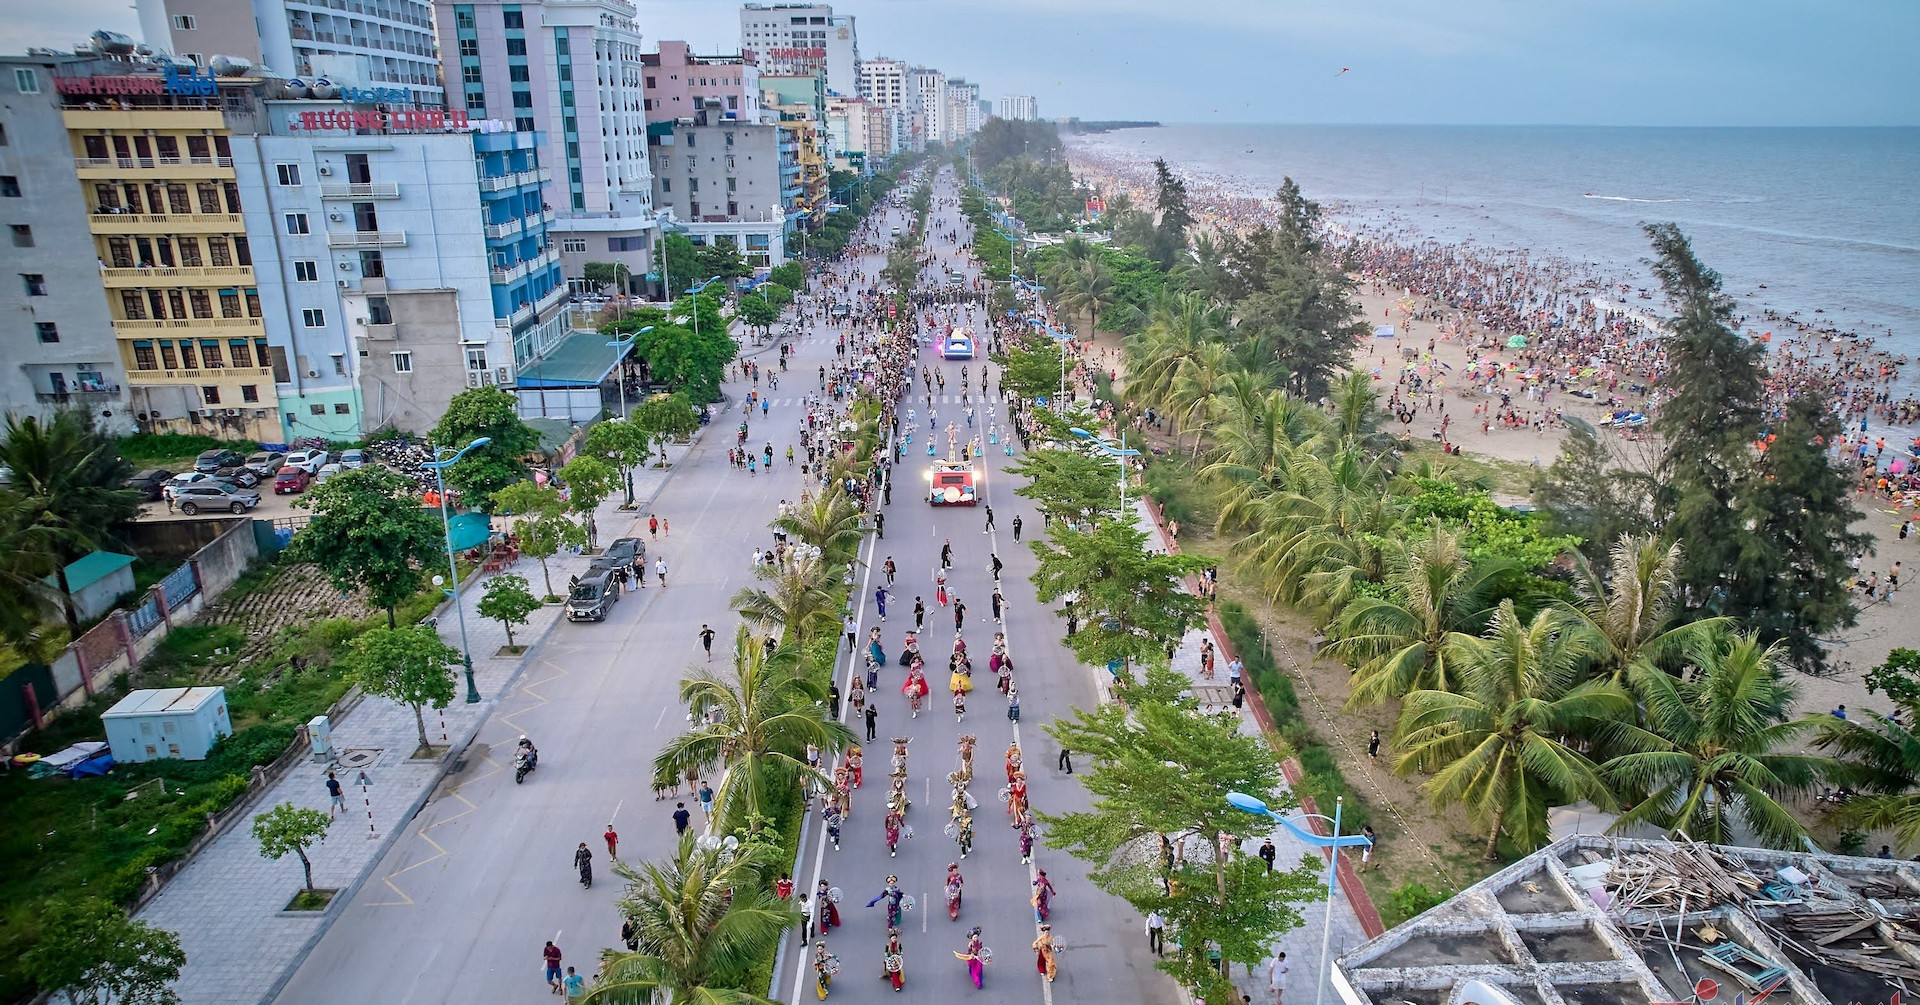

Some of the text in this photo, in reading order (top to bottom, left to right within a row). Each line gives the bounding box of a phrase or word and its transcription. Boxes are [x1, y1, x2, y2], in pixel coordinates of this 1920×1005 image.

[164, 65, 218, 96] Hotel
[341, 86, 411, 104] Hotel
[389, 109, 445, 130] LINH
